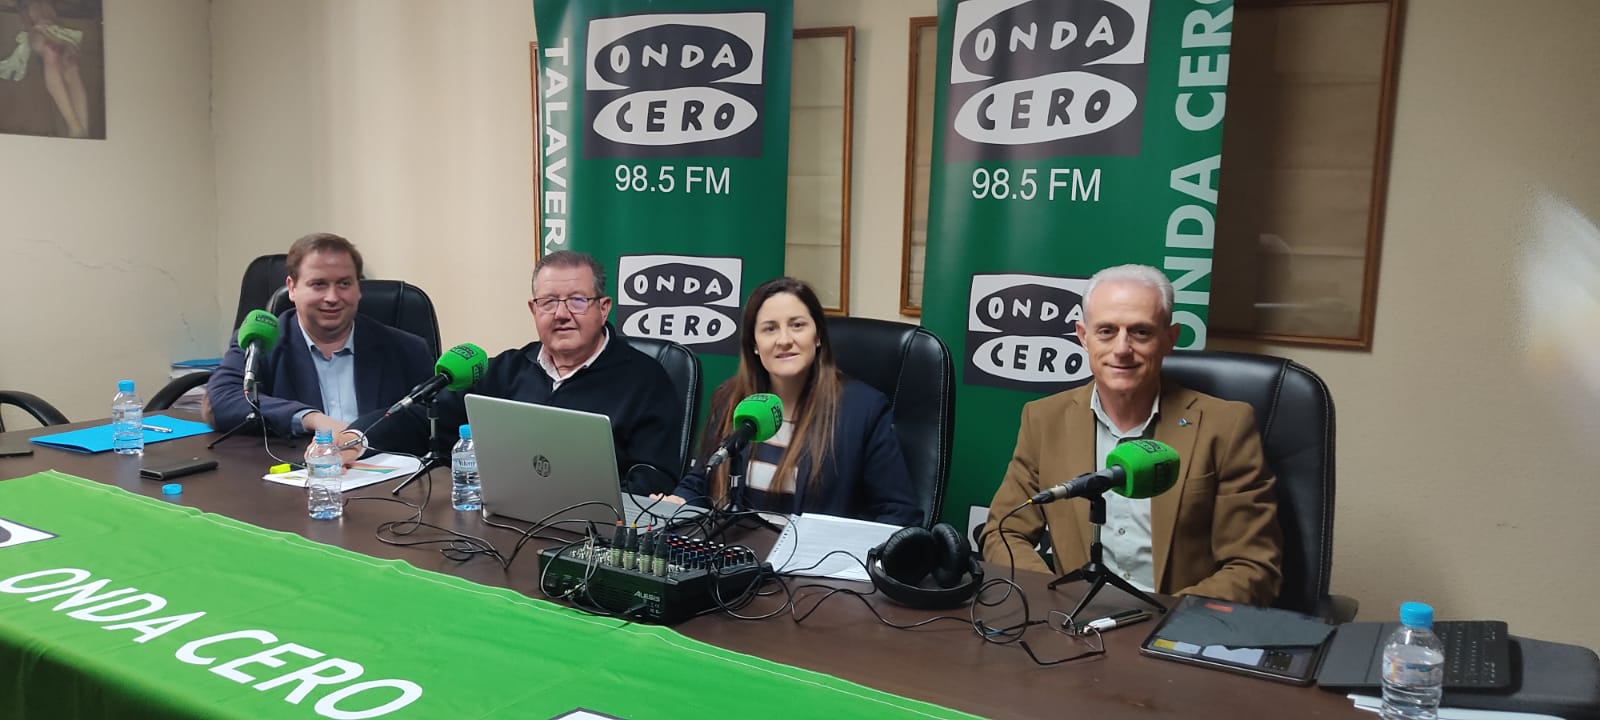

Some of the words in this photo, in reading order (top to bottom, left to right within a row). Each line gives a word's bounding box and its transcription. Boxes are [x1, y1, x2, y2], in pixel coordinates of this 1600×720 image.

[974, 15, 1115, 62] ONDA
[610, 43, 737, 73] ONDA
[1175, 0, 1234, 131] CER
[616, 99, 736, 133] CERO
[976, 87, 1112, 131] CERO
[615, 164, 675, 193] 98.5
[685, 166, 731, 195] FM
[971, 167, 1038, 200] 98.5
[1049, 168, 1101, 202] FM
[1164, 153, 1222, 351] ONDA
[633, 274, 723, 295] ONDA
[638, 313, 722, 337] CERO
[988, 296, 1084, 324] ONDA
[990, 342, 1083, 375] CERO
[535, 455, 550, 478] hp
[0, 567, 206, 643] ONDA
[175, 629, 423, 720] CERO
